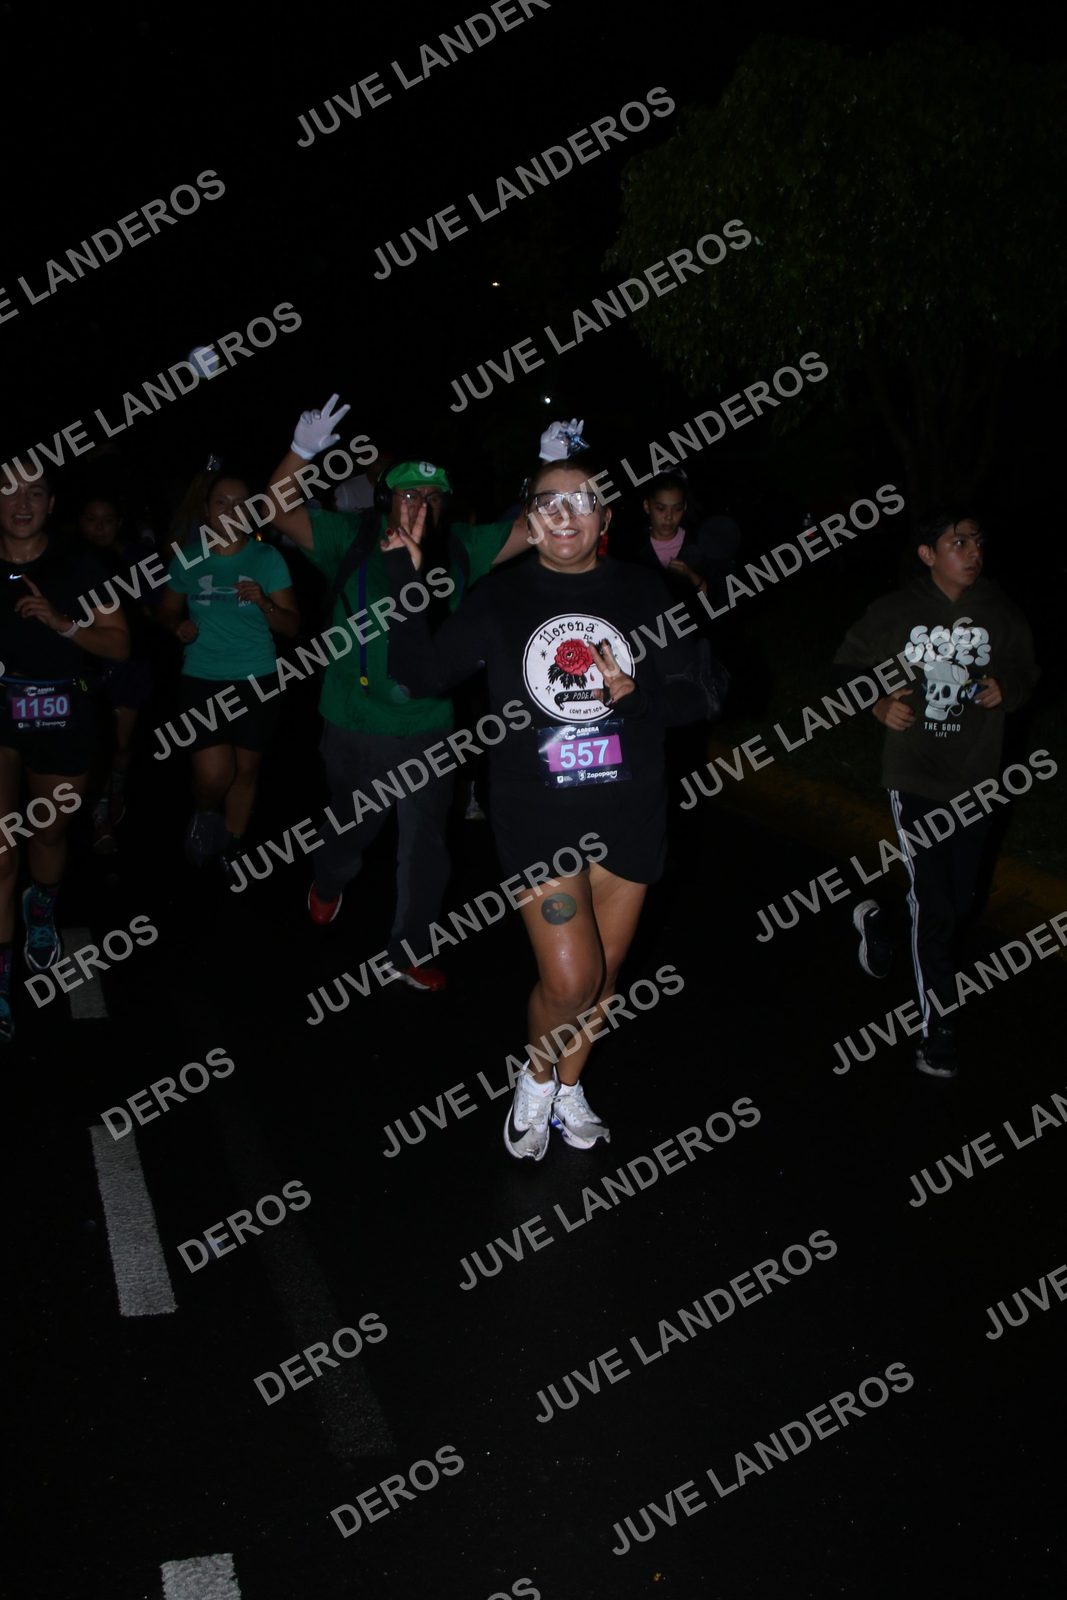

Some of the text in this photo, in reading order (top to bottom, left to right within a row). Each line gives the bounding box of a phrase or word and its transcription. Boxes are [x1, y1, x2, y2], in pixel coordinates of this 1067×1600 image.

[16, 695, 68, 717] 1150
[924, 722, 961, 732] THE GOOD
[560, 739, 609, 768] 557
